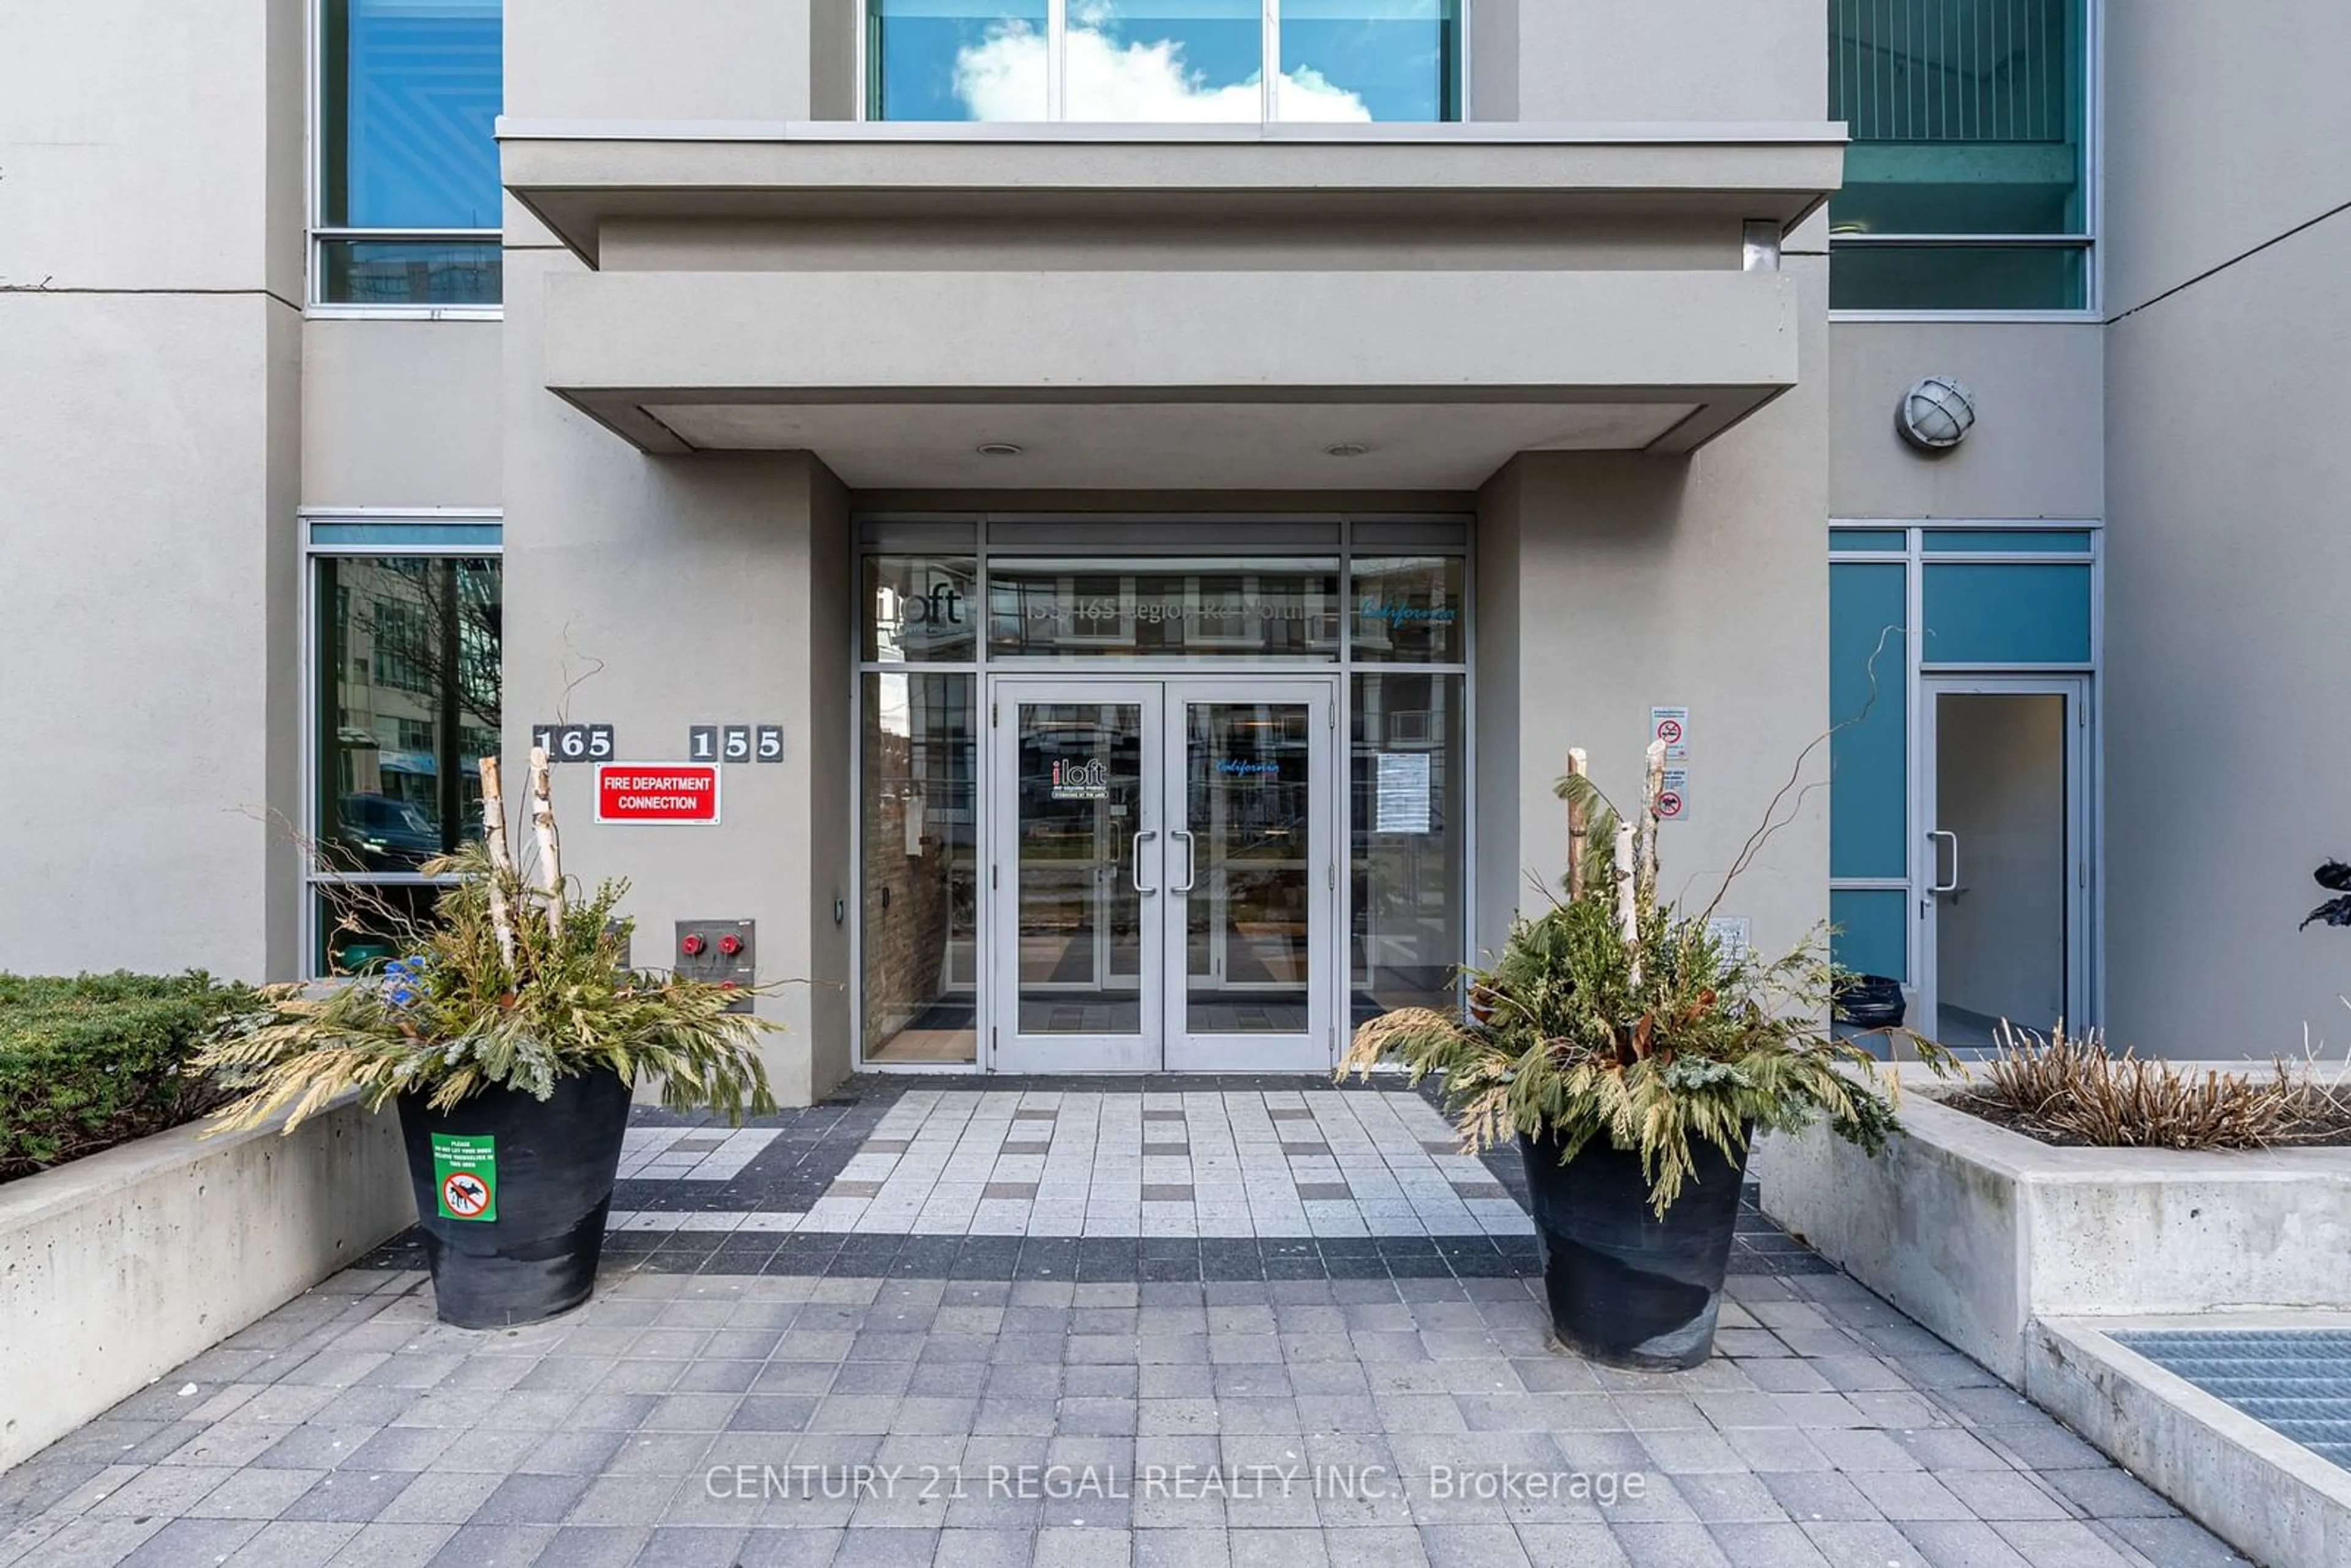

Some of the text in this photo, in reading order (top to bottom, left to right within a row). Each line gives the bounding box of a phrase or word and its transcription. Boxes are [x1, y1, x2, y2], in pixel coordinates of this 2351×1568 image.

[1078, 598, 1116, 620] 165
[535, 731, 610, 757] 165
[693, 731, 781, 757] 155
[604, 777, 711, 790] FIRE DEPARTMENT
[618, 797, 697, 809] CONNECTION
